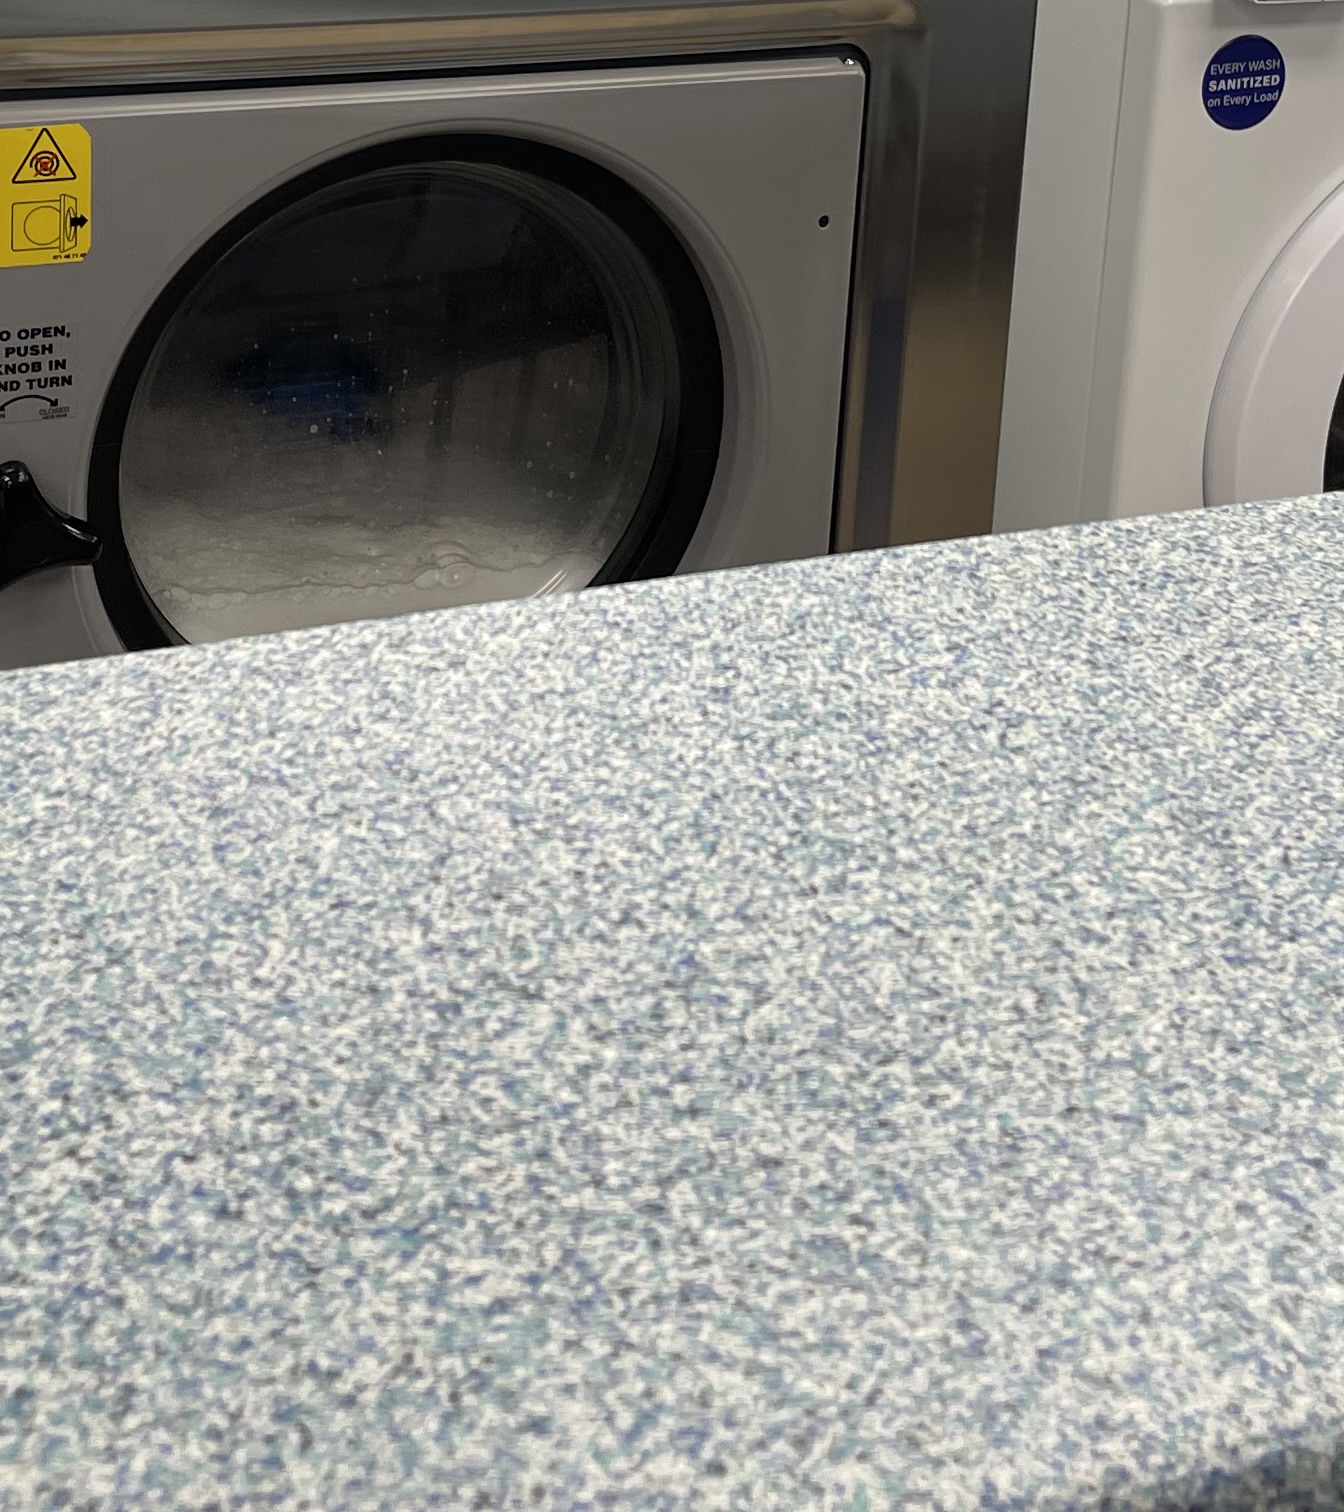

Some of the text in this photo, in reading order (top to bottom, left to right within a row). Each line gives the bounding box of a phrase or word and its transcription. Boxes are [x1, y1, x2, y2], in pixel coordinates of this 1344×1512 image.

[1210, 58, 1281, 76] EVERY WASH
[1208, 75, 1281, 92] SANITIZED
[1207, 90, 1279, 108] on Every Load
[17, 325, 71, 340] OPEN,
[4, 343, 53, 358] PUSH
[48, 359, 67, 371] IN
[26, 374, 73, 390] TURN
